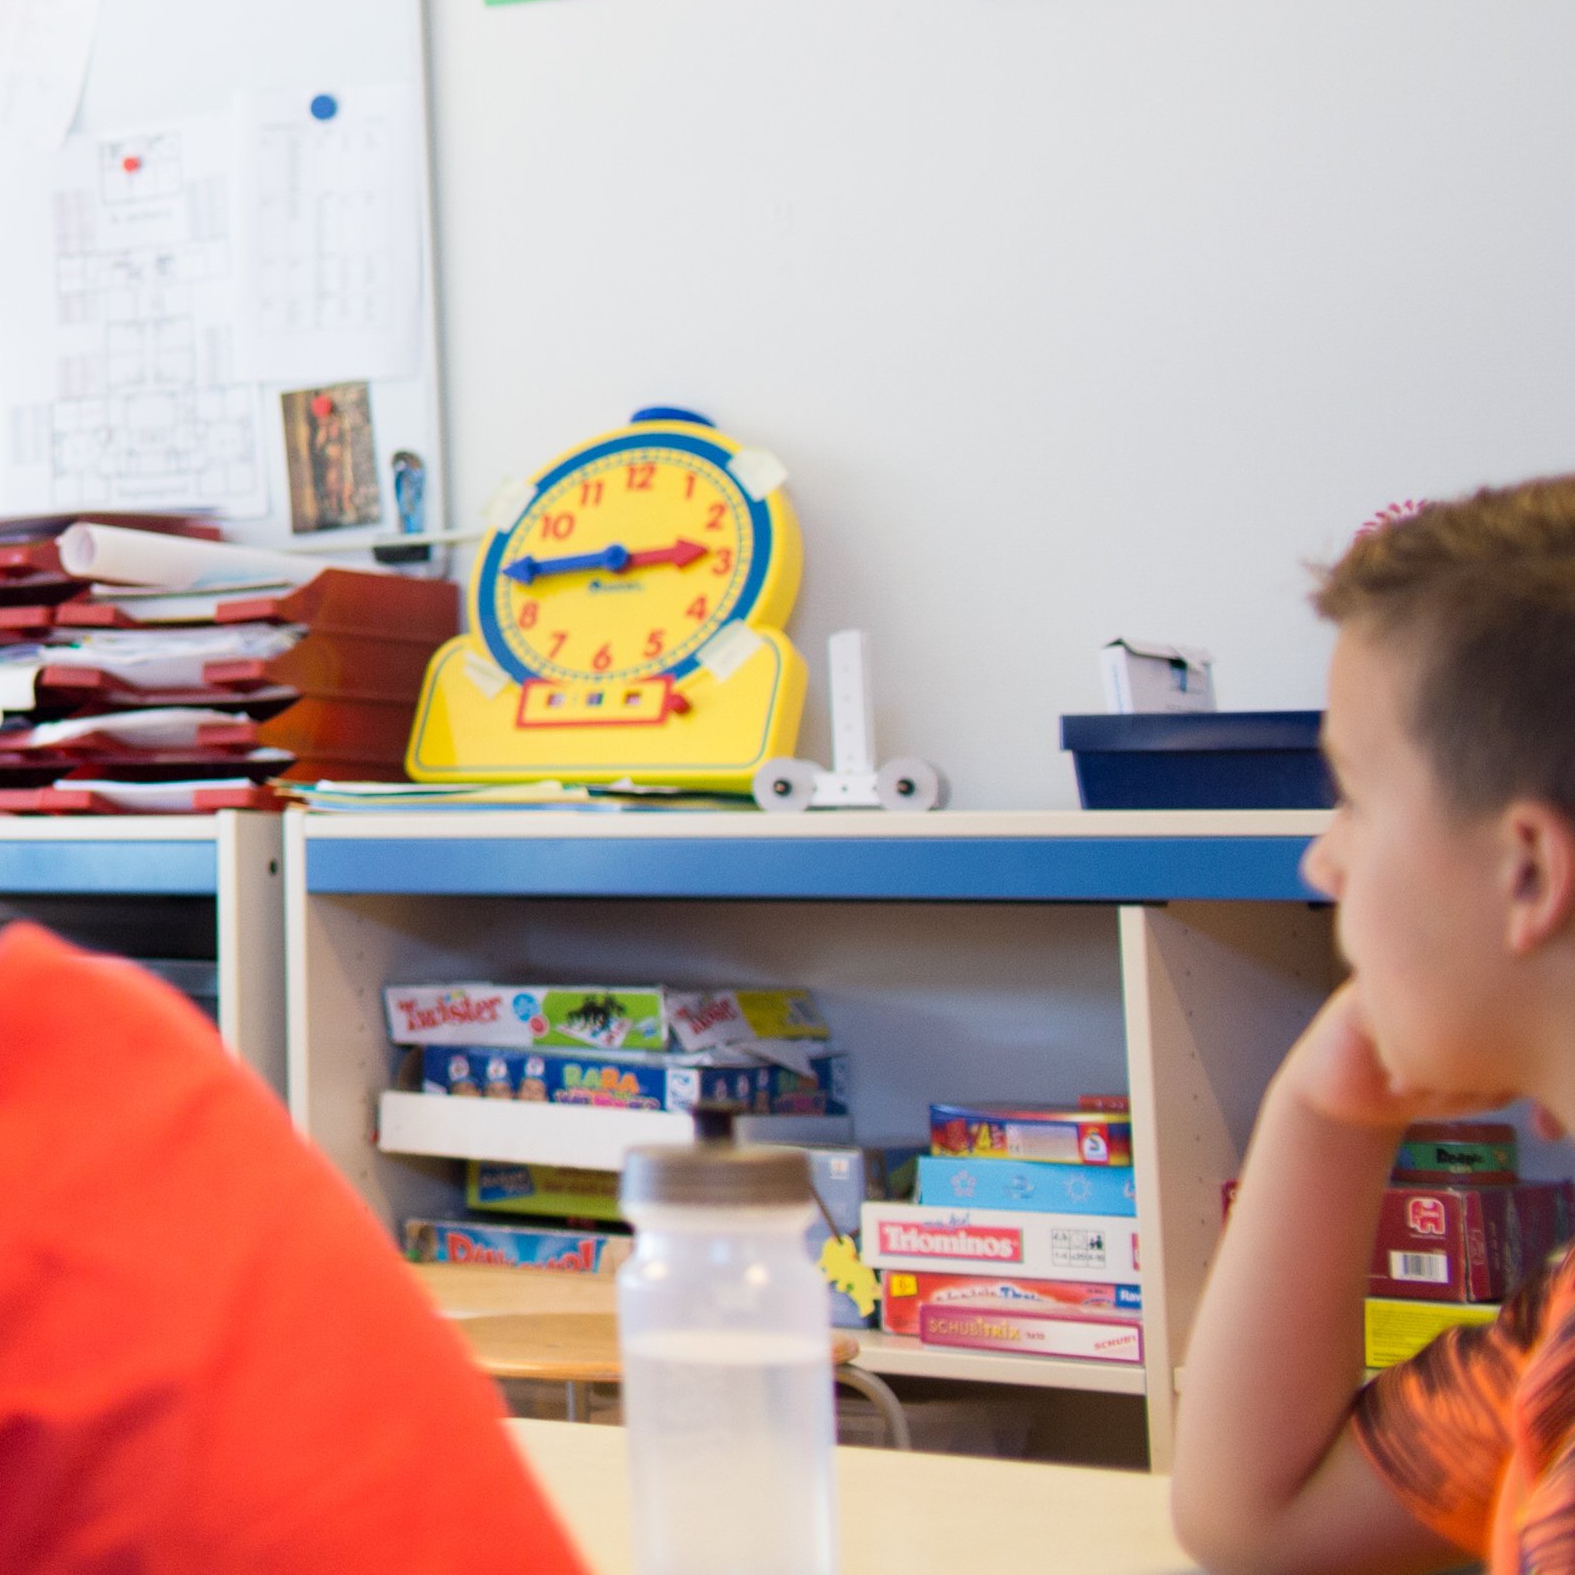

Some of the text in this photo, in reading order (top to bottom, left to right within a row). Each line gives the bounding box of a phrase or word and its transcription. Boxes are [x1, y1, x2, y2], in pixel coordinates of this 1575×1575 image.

[626, 461, 656, 491] 12
[683, 474, 697, 500] 1
[580, 481, 604, 507] 11
[541, 513, 576, 540] 10
[706, 502, 727, 530] 2
[712, 549, 732, 576] 3
[519, 601, 539, 629] 8
[686, 595, 707, 621] 4
[550, 631, 569, 658] 7
[593, 644, 612, 672] 6
[644, 630, 666, 658] 5
[397, 996, 502, 1031] Twister
[885, 1224, 1014, 1259] Triominos
